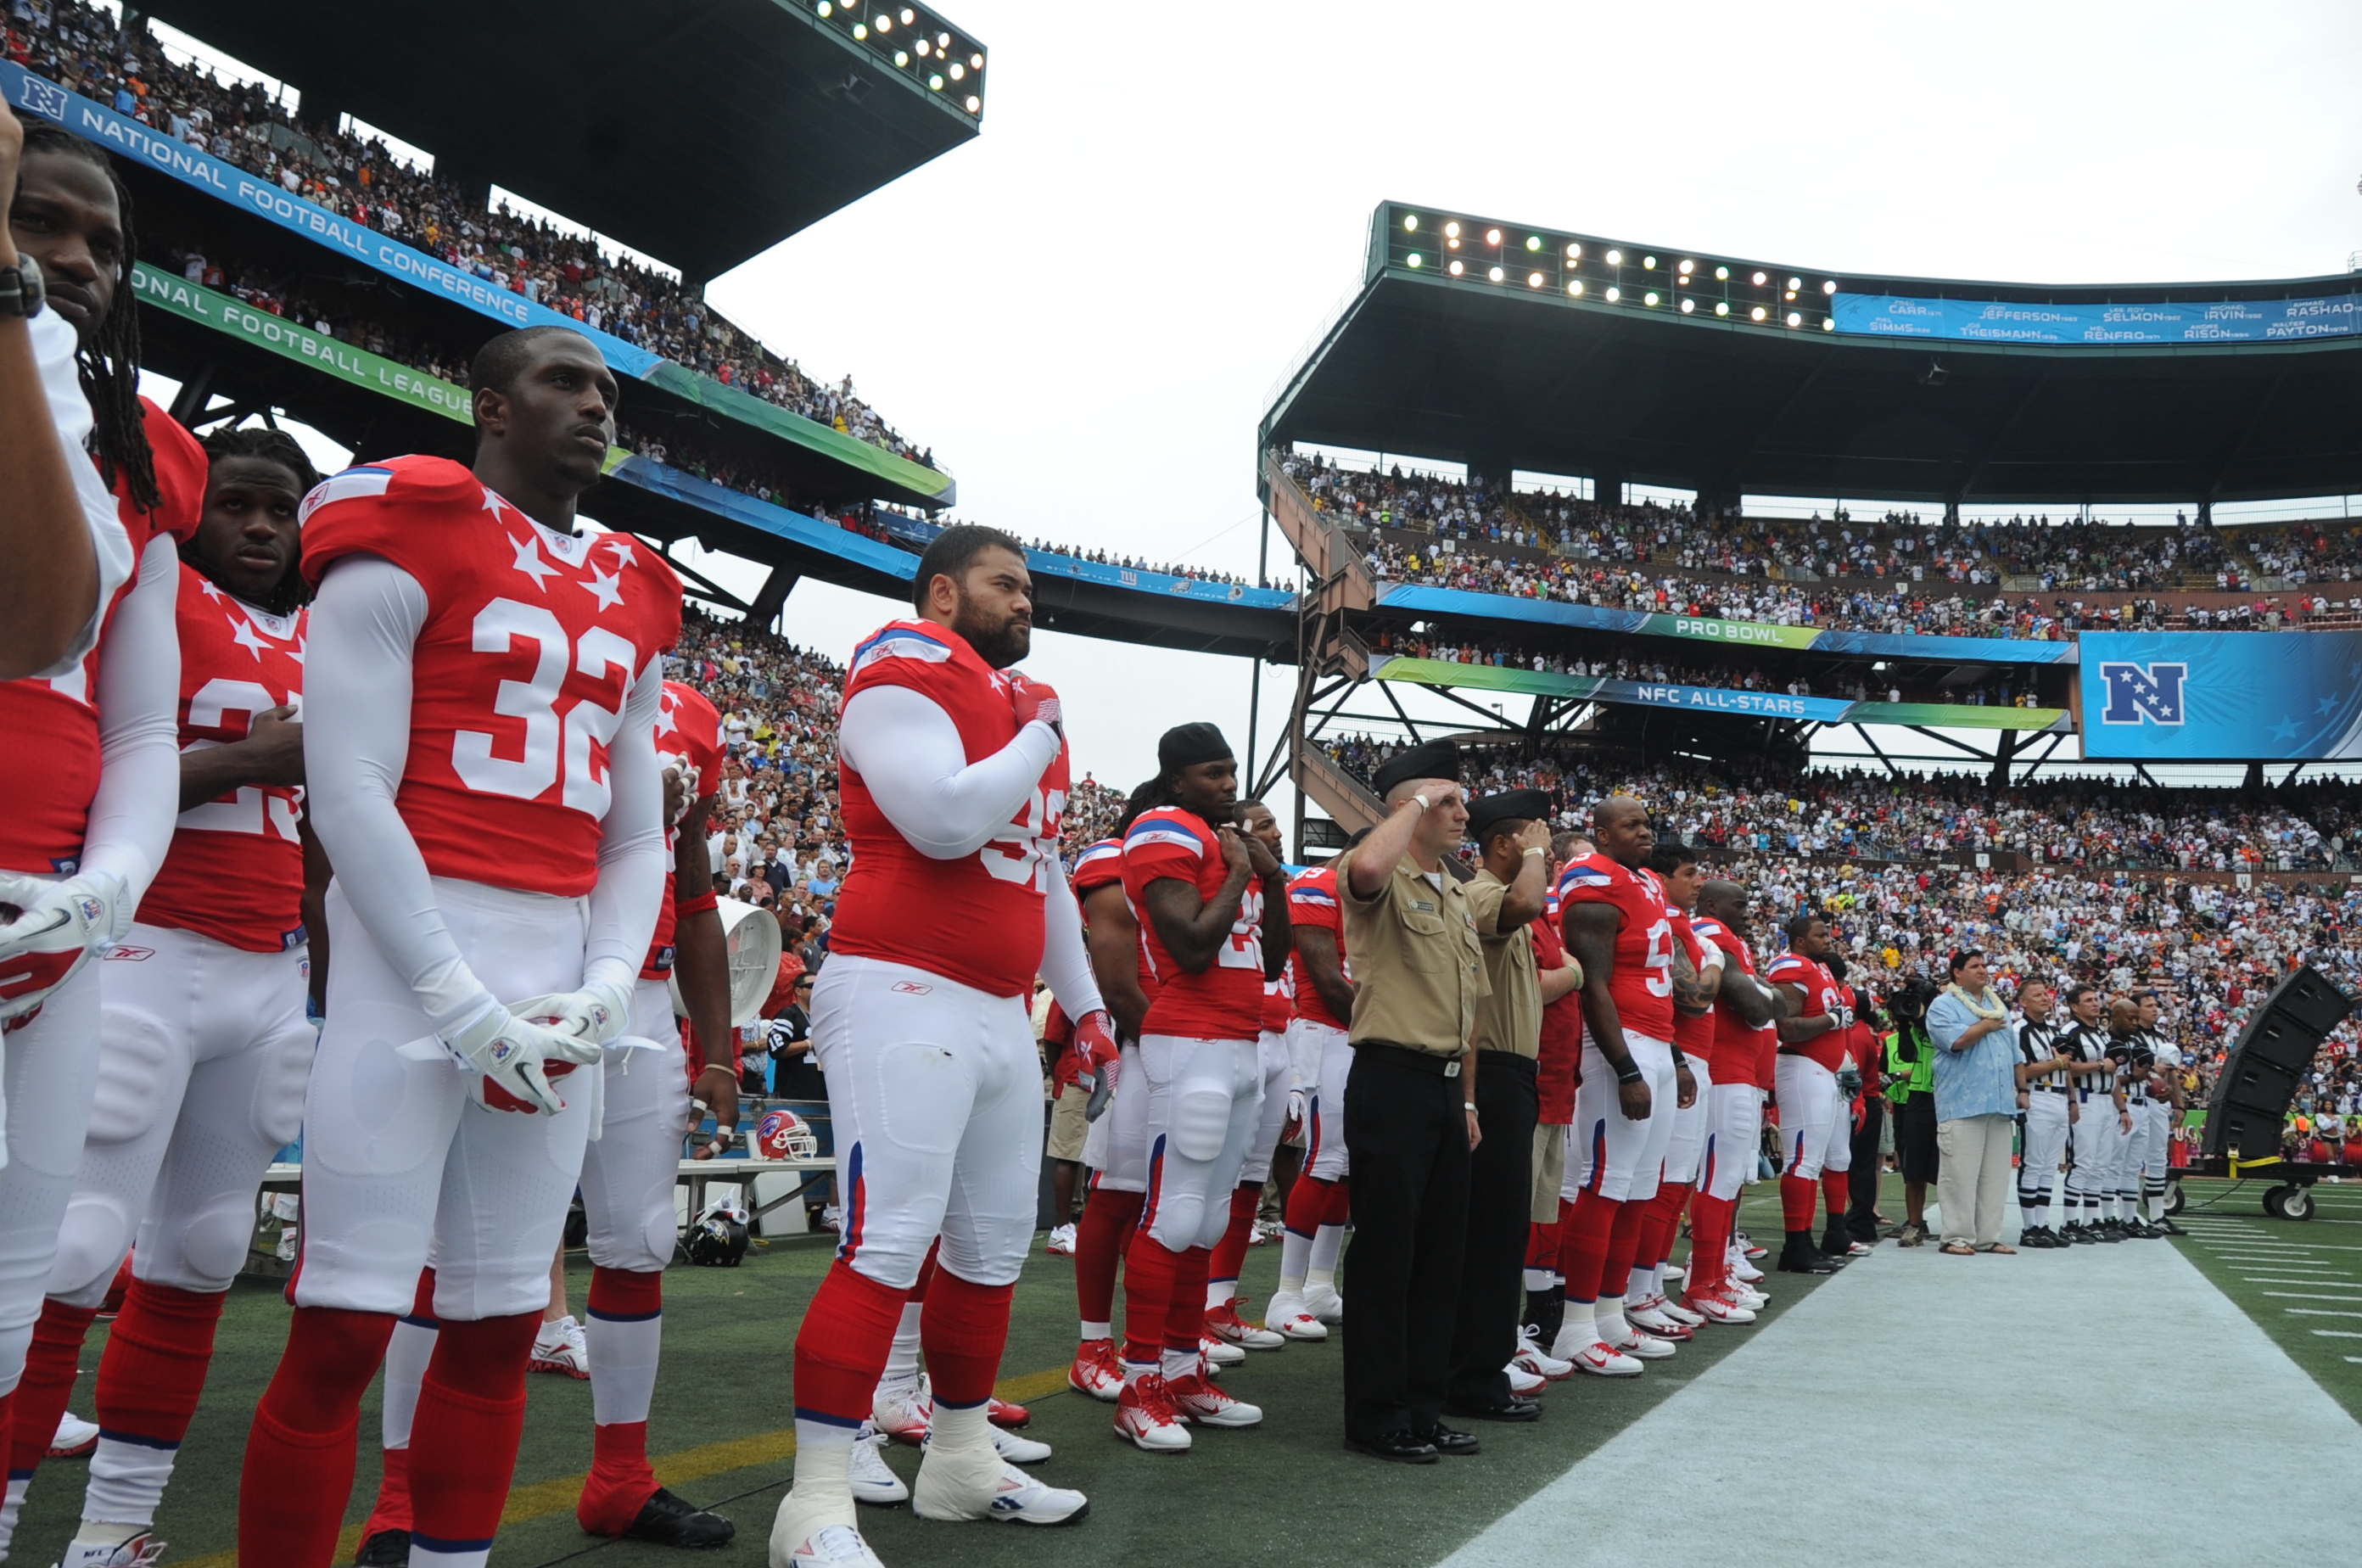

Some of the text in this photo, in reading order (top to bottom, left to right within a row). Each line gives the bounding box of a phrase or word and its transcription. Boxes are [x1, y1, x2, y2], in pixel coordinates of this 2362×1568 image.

[82, 108, 529, 322] NATIONAL FOOTBALL CONFERENCE
[1889, 305, 1927, 315] CARR
[2286, 303, 2354, 317] RASHAD
[2292, 300, 2325, 308] AHMAD
[1979, 310, 2061, 322] JEFFERSON
[2103, 312, 2163, 322] SELMON
[2204, 311, 2244, 321] IRVIN
[1870, 322, 1913, 333] SIMMS
[1960, 327, 2040, 339] THEISMANN
[2266, 324, 2329, 337] PAYTON
[2084, 330, 2145, 340] RENFRO
[2184, 329, 2230, 339] RISON
[131, 268, 473, 417] ONAL FOOTBALL LEAGUE
[1676, 619, 1783, 643] PRO BOWL
[2099, 662, 2188, 725] N
[1637, 686, 1805, 714] NFC ALL-STARS
[452, 596, 635, 821] 32
[83, 1549, 104, 1558] NFL
